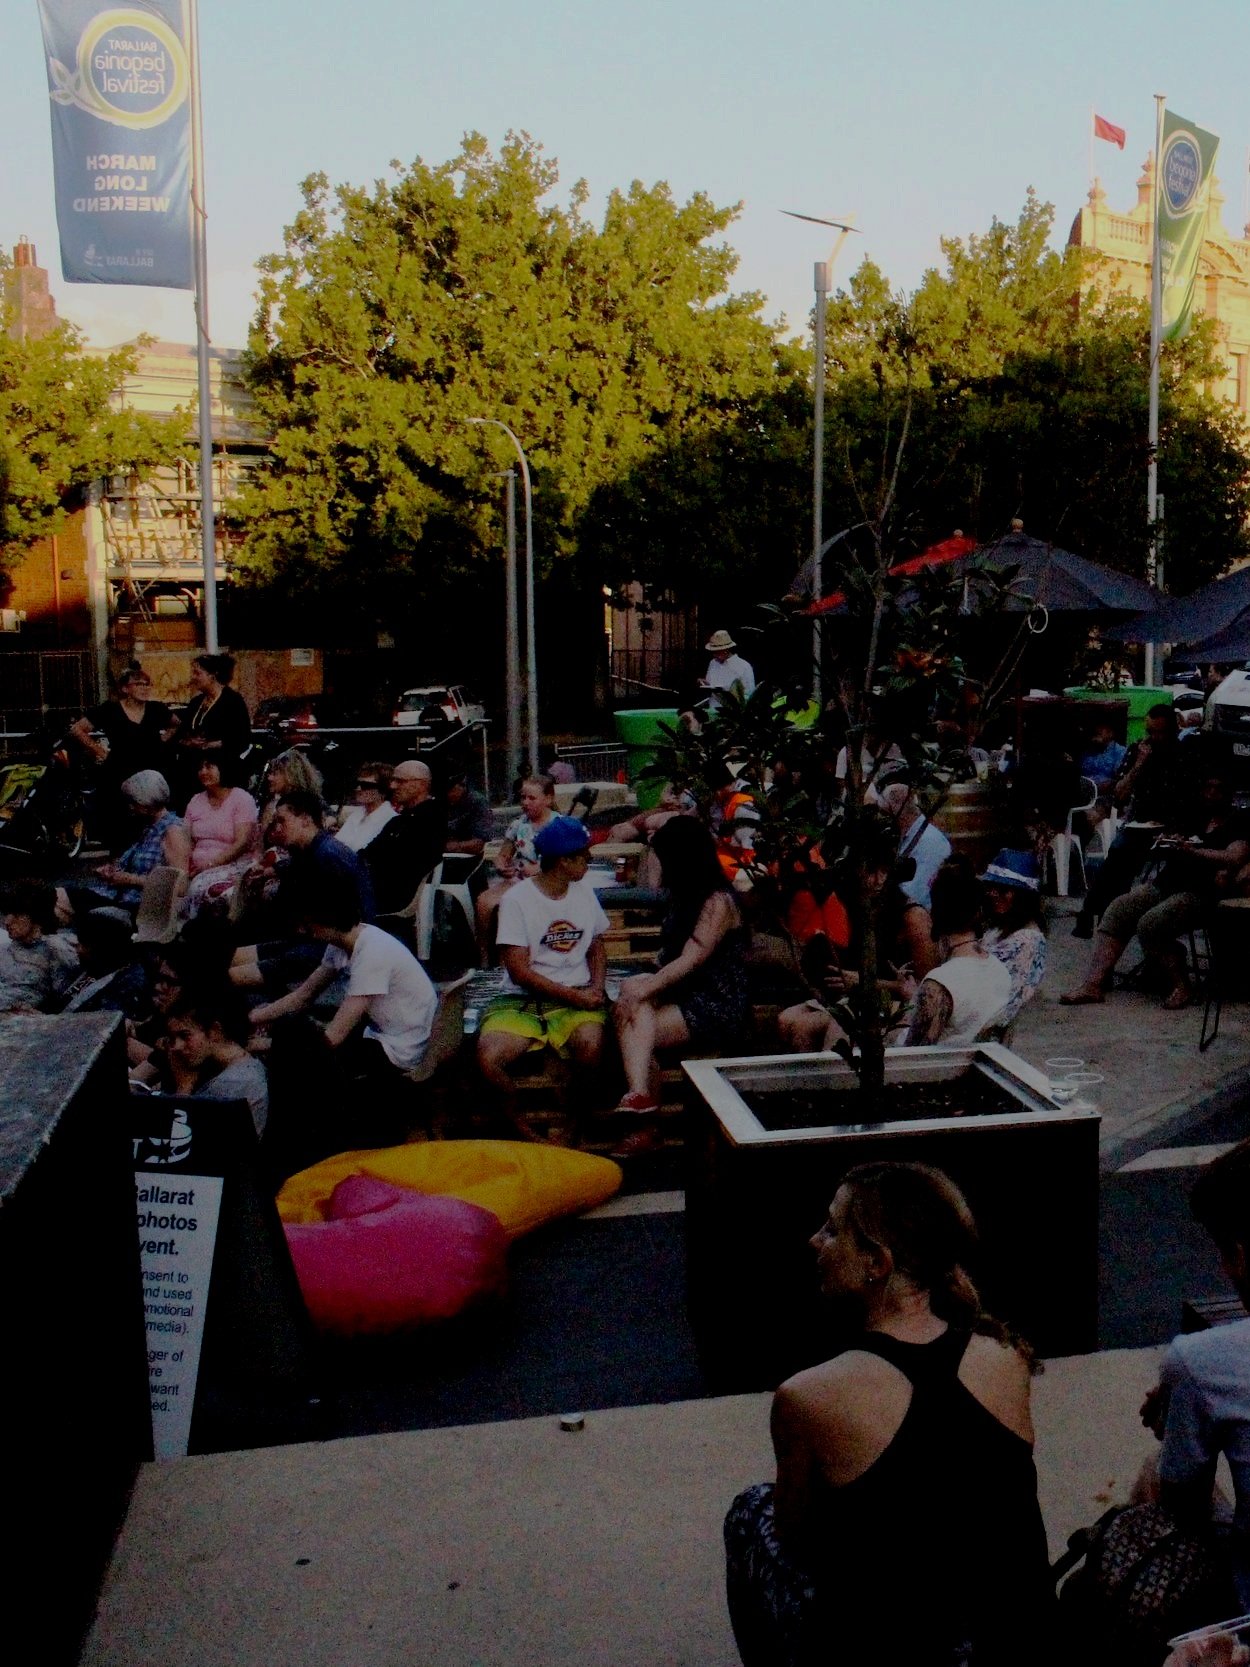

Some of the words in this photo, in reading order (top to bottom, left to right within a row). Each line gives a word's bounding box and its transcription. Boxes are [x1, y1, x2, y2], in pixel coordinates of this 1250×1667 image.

[136, 1186, 195, 1205] allarat
[139, 1239, 179, 1255] vent.
[140, 1271, 173, 1281] nsent
[178, 1272, 189, 1283] to
[142, 1287, 160, 1298] nd
[163, 1289, 192, 1300] used
[143, 1304, 194, 1317] motional
[147, 1350, 168, 1362] ger
[171, 1350, 184, 1362] of
[149, 1367, 162, 1377] re
[150, 1384, 179, 1396] want
[151, 1400, 170, 1411] ed.
